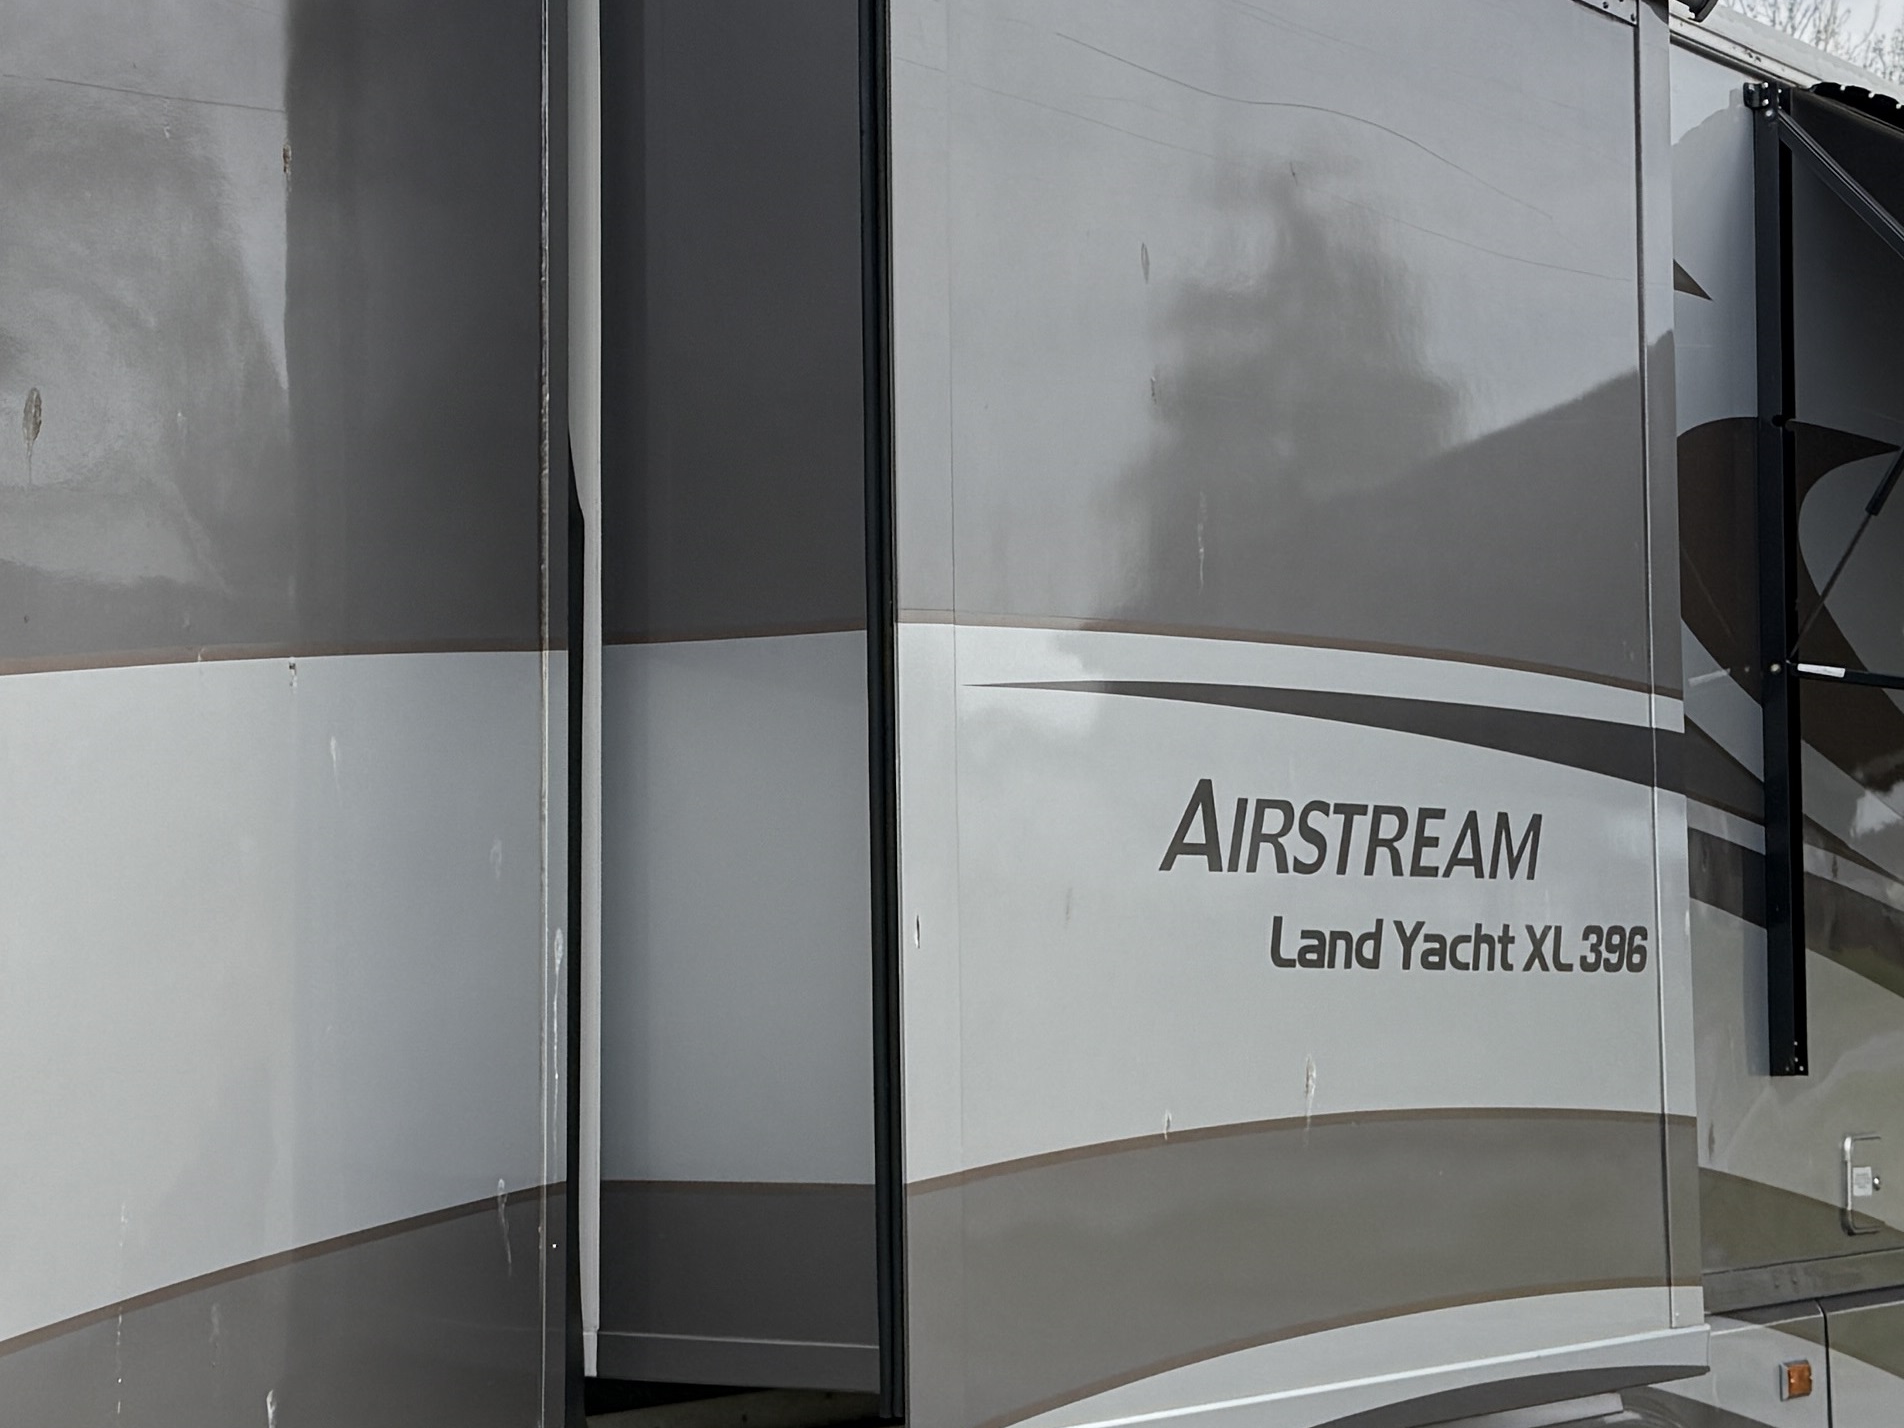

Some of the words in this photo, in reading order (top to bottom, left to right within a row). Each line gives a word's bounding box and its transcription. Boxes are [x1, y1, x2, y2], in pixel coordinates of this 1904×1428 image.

[1159, 778, 1543, 881] AIRSTREAM
[1270, 916, 1384, 970] Land
[1393, 920, 1515, 972] Yacht
[1523, 924, 1574, 972] XL
[1579, 924, 1649, 973] 396
